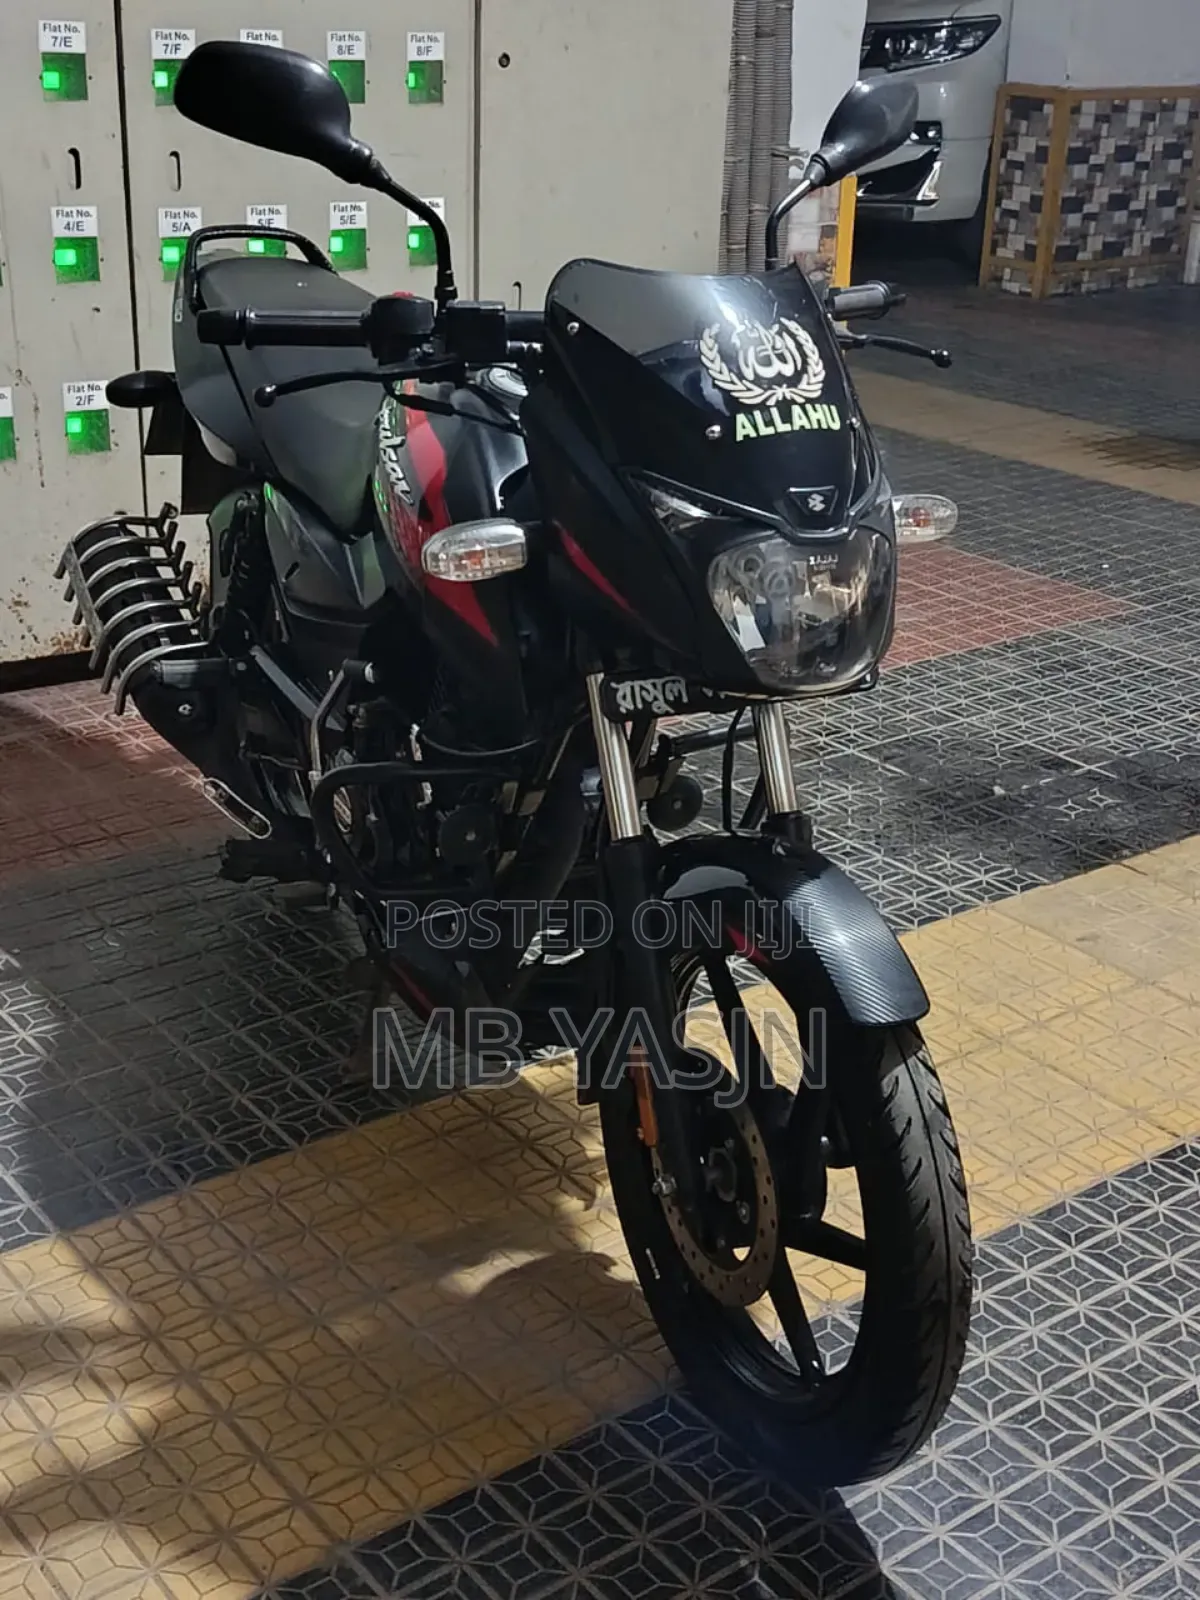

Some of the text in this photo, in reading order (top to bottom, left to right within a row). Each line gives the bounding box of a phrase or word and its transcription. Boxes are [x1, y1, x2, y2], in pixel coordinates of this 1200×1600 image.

[42, 22, 81, 34] Flat No.
[50, 35, 73, 48] 7/E
[155, 31, 190, 41] Flat No.
[246, 32, 280, 42] Flat No.
[330, 33, 362, 43] Flat No.
[410, 34, 440, 43] Flat No.
[162, 43, 182, 56] 7/F
[337, 44, 355, 56] 8/E
[416, 45, 433, 57] 8/F
[55, 208, 92, 219] Flat No.
[250, 207, 282, 217] Flat No.
[333, 203, 365, 213] Flat No.
[164, 210, 199, 220] Flat No.
[339, 214, 357, 225] 5/E
[64, 221, 85, 232] 4/E
[171, 222, 192, 233] 5/A
[67, 383, 103, 394] Flat No.
[75, 394, 95, 406] 2/F
[735, 403, 841, 443] ALLAHU
